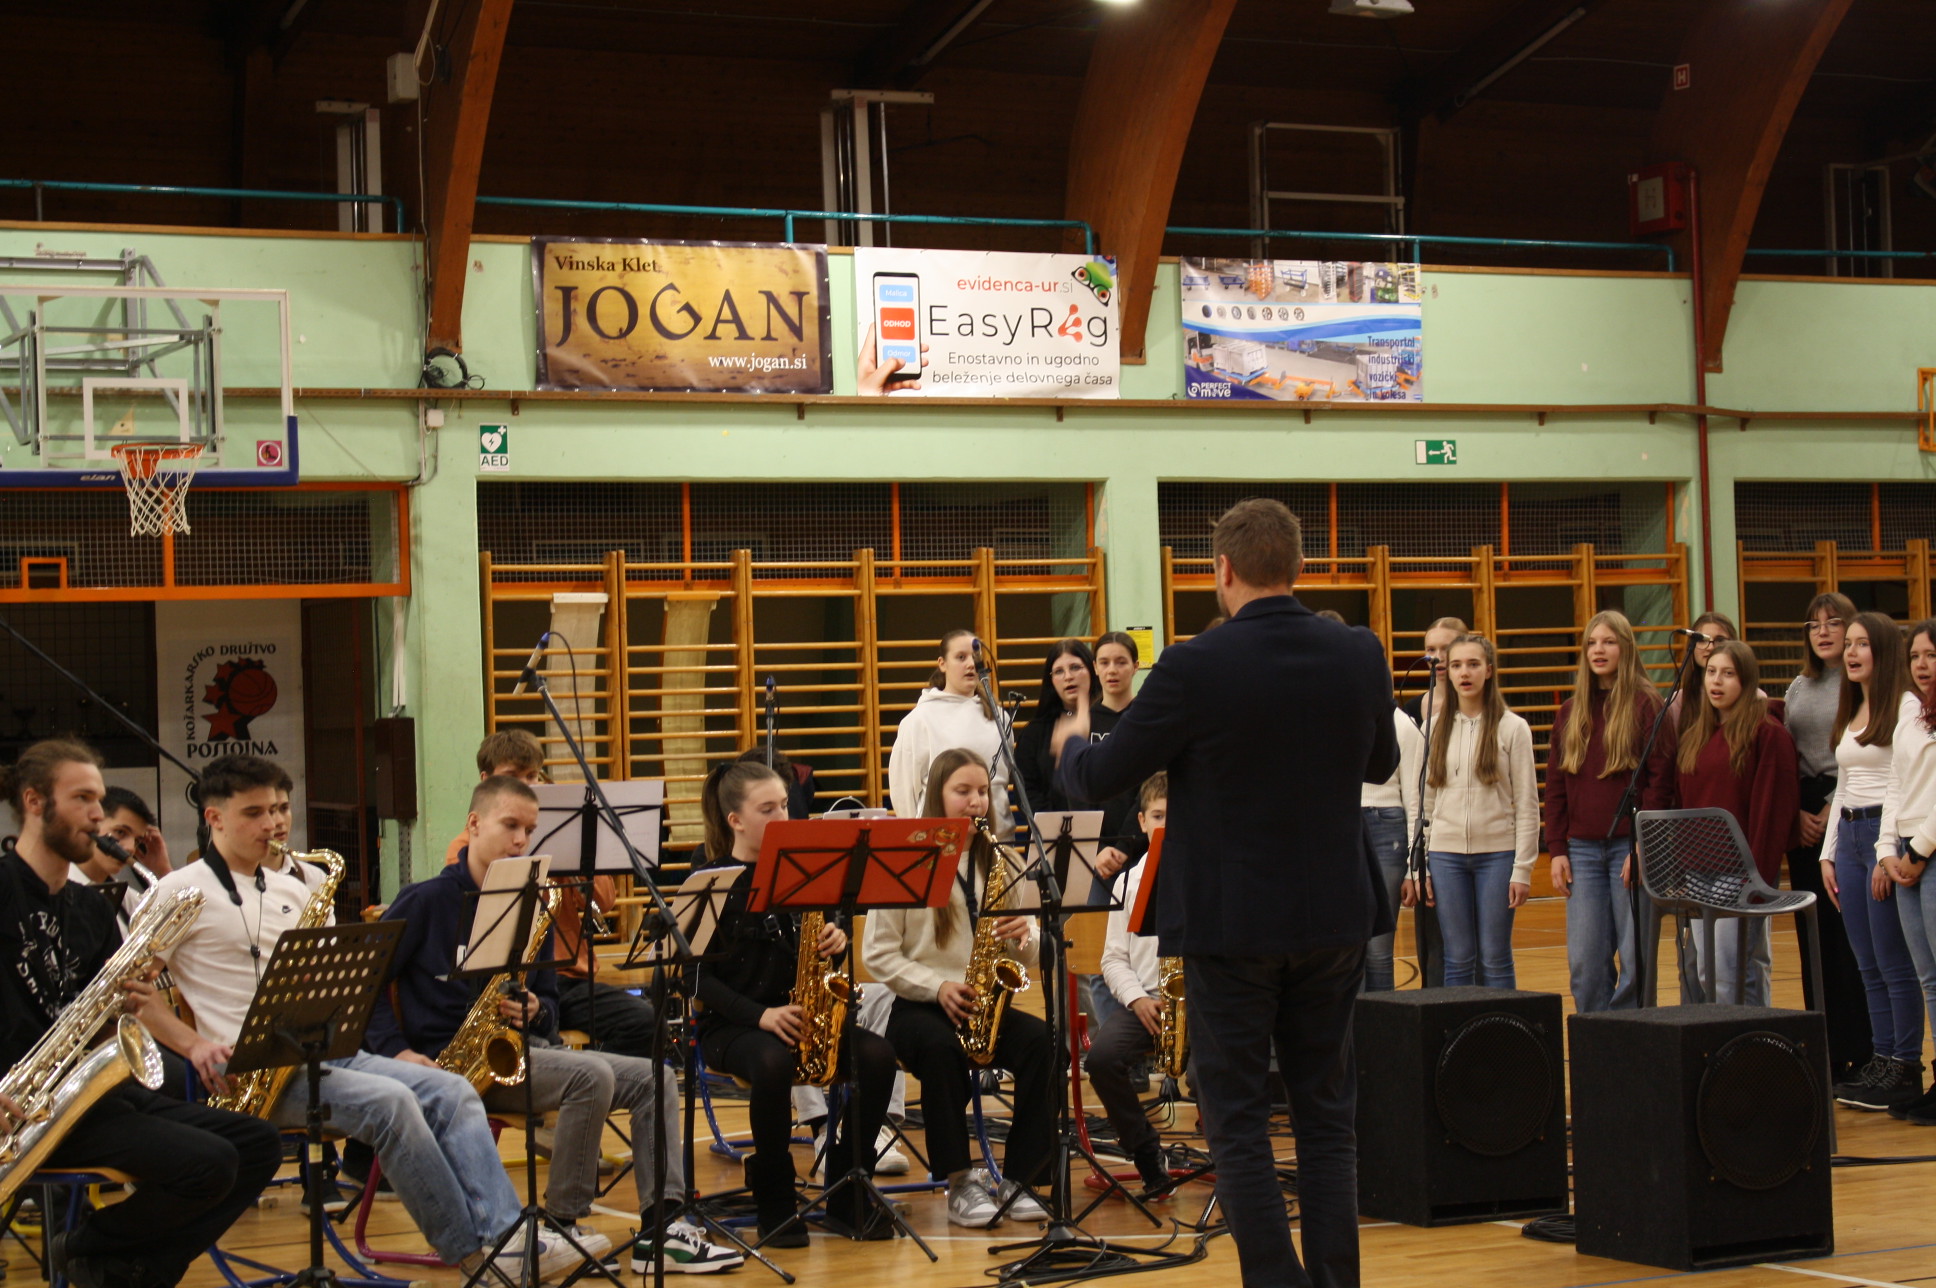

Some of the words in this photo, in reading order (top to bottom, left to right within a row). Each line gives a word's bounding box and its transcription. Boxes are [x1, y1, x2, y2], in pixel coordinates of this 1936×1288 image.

[1677, 70, 1686, 85] H
[554, 255, 616, 272] Vinska
[622, 257, 658, 273] Klet
[957, 275, 1073, 294] evidenca-ur.si
[554, 282, 810, 348] JOGAN
[883, 319, 912, 328] ODHOD
[1367, 335, 1415, 349] Transportni
[708, 352, 807, 373] www.jogan.si
[948, 352, 1023, 366] Enostavno
[1026, 352, 1040, 366] in
[1044, 353, 1100, 369] ugodno
[932, 370, 1002, 386] beleženje
[1006, 371, 1081, 387] delovnega
[1084, 372, 1113, 386] časa
[481, 455, 509, 466] AED
